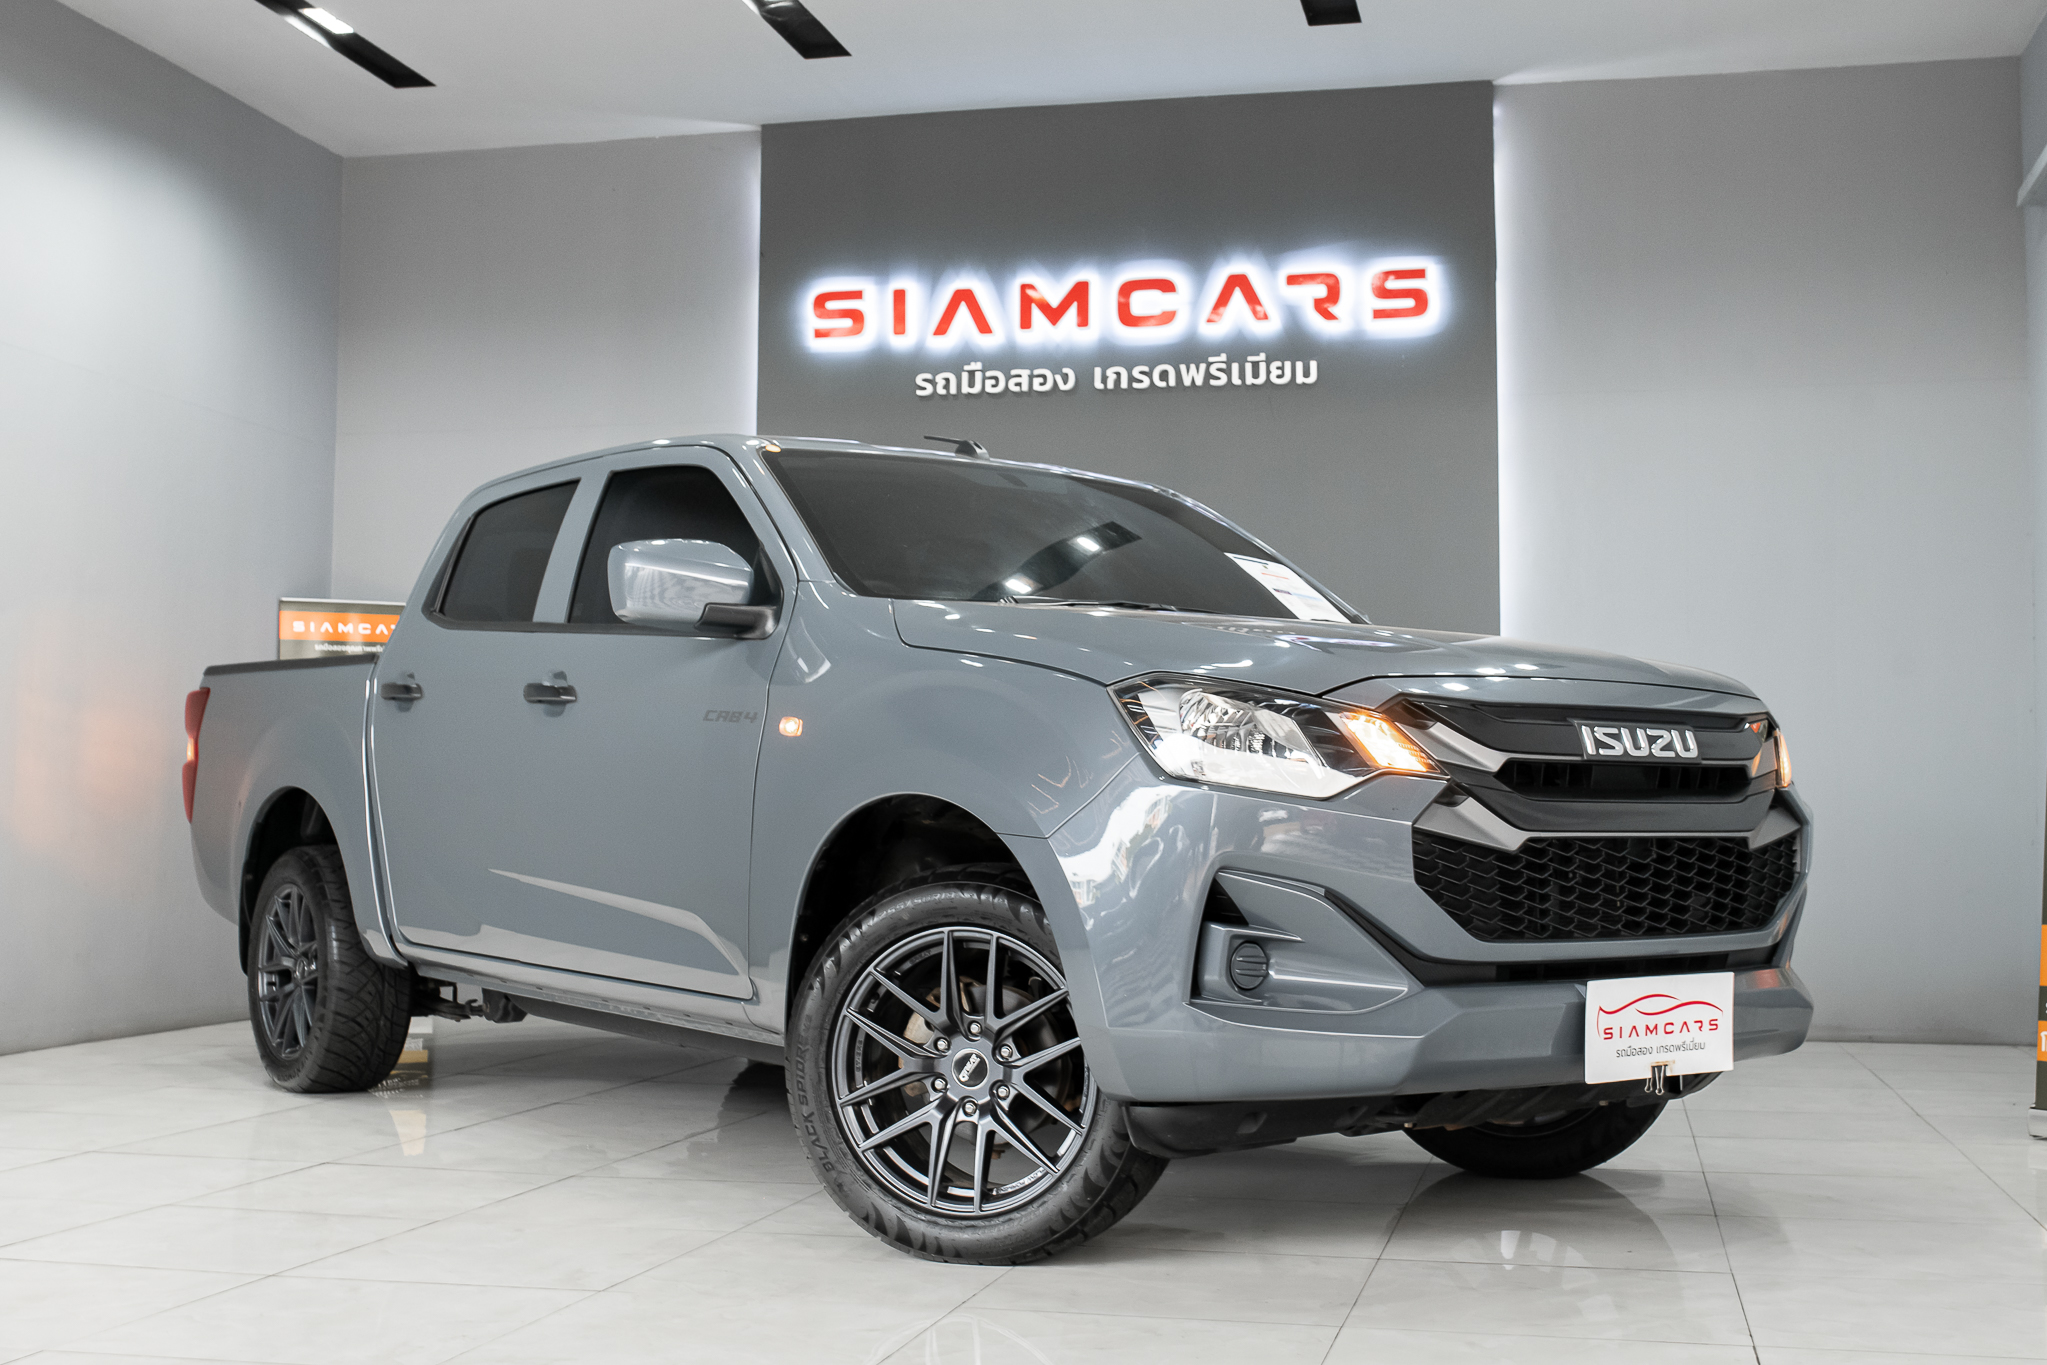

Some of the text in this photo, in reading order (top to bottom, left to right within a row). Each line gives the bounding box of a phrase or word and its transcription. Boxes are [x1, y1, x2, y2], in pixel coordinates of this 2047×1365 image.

[813, 268, 1428, 338] SIAMCARS
[915, 352, 1318, 397] รถมือสอง เกรดพรีเมียม
[293, 620, 396, 635] SIAMCA
[1581, 725, 1698, 758] ISUZU
[1603, 1018, 1719, 1040] SIAMCARS
[1616, 1045, 1653, 1058] รถมือสอง
[802, 1111, 835, 1172] BLACK
